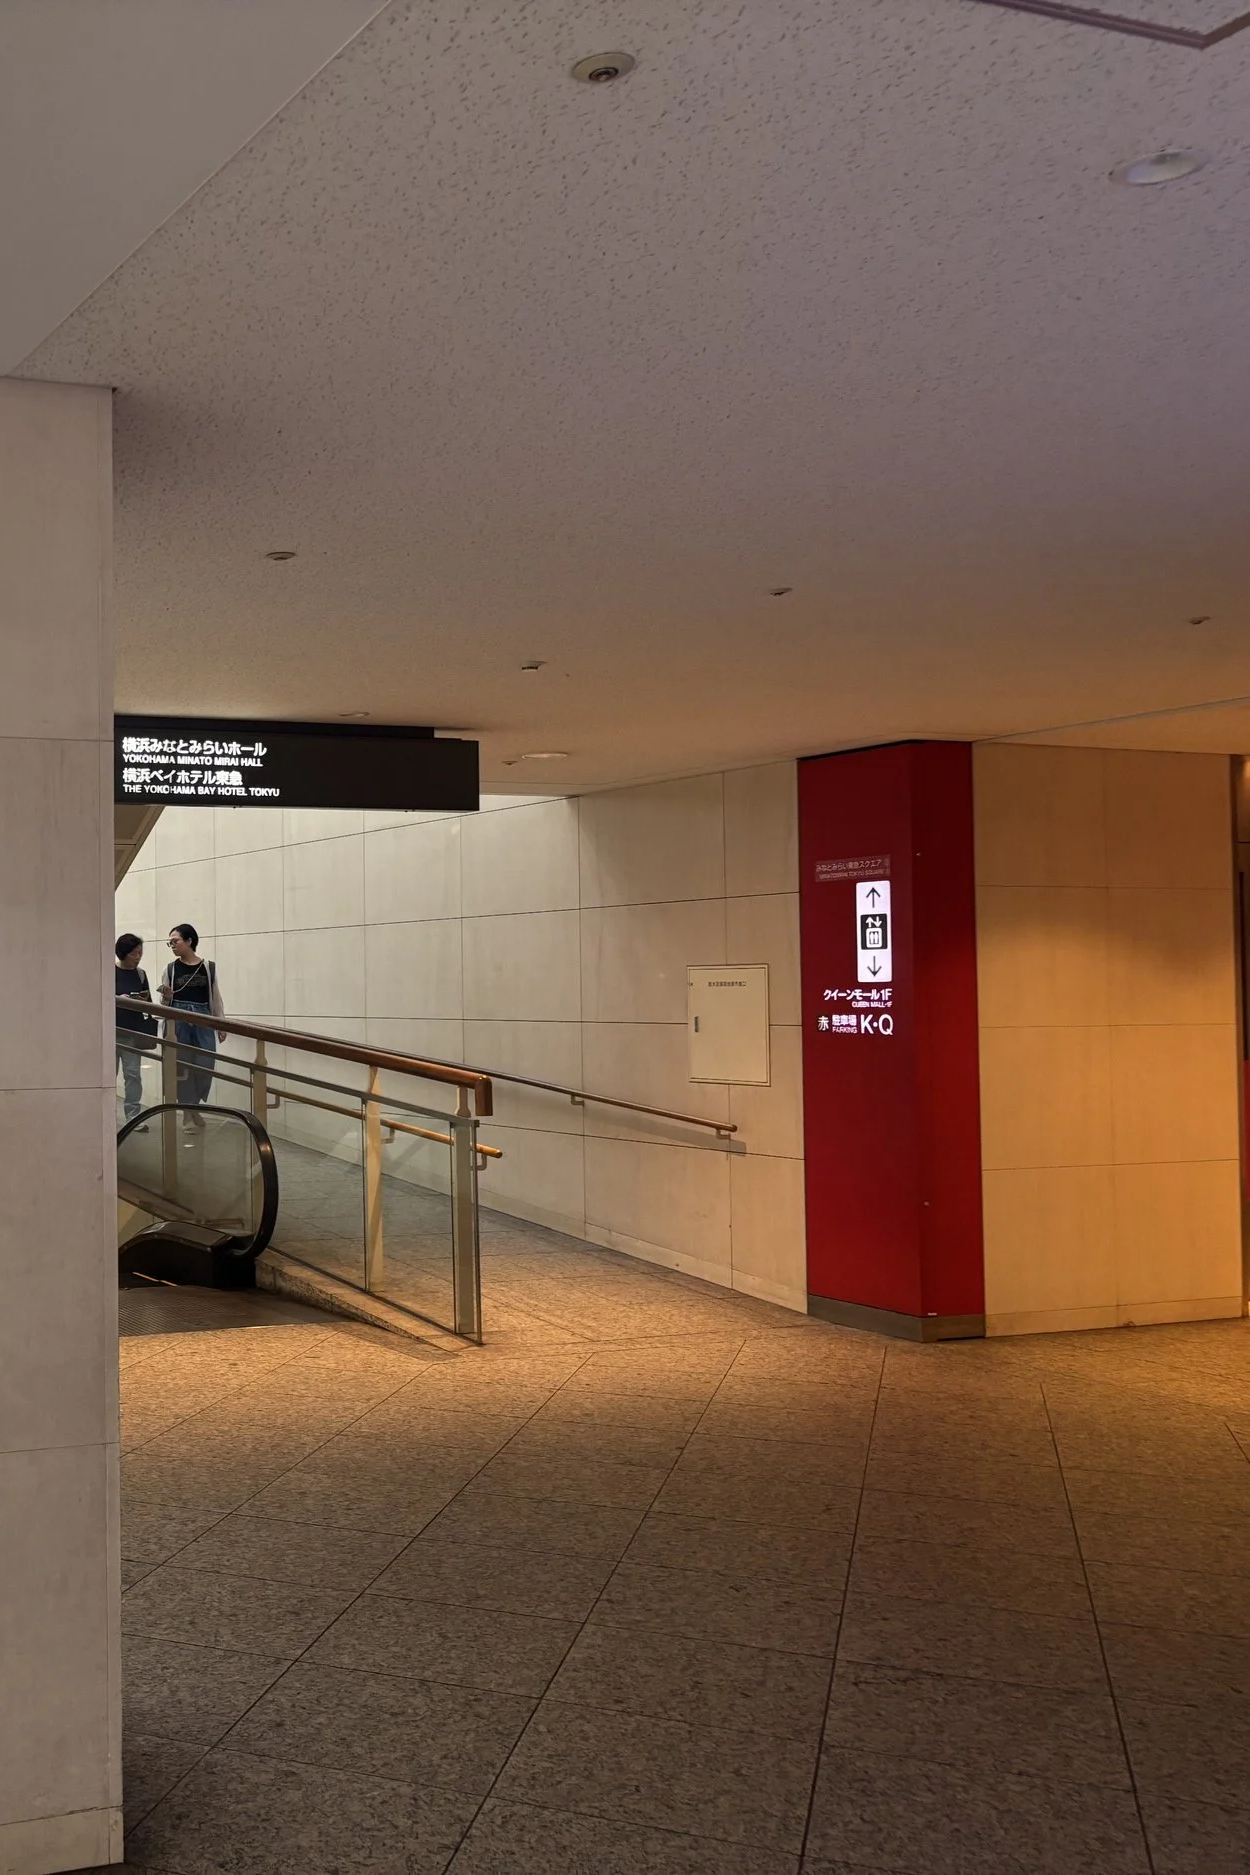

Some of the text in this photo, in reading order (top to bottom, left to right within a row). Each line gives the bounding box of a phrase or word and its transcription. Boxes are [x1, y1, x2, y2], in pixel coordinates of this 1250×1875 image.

[122, 737, 267, 756] 横浜みなとみらいホール
[123, 754, 263, 767] YOKOHAMA MINATO MIRAI HALL
[123, 768, 243, 786] 横浜ベイホテル東急
[123, 784, 280, 797] THE YOKOHAMA BAY HOTEL TOKYU
[823, 989, 893, 1001] クイーンモール1F
[818, 1015, 830, 1031] 赤
[832, 1014, 857, 1026] 駐車場
[832, 1026, 858, 1034] PARKING
